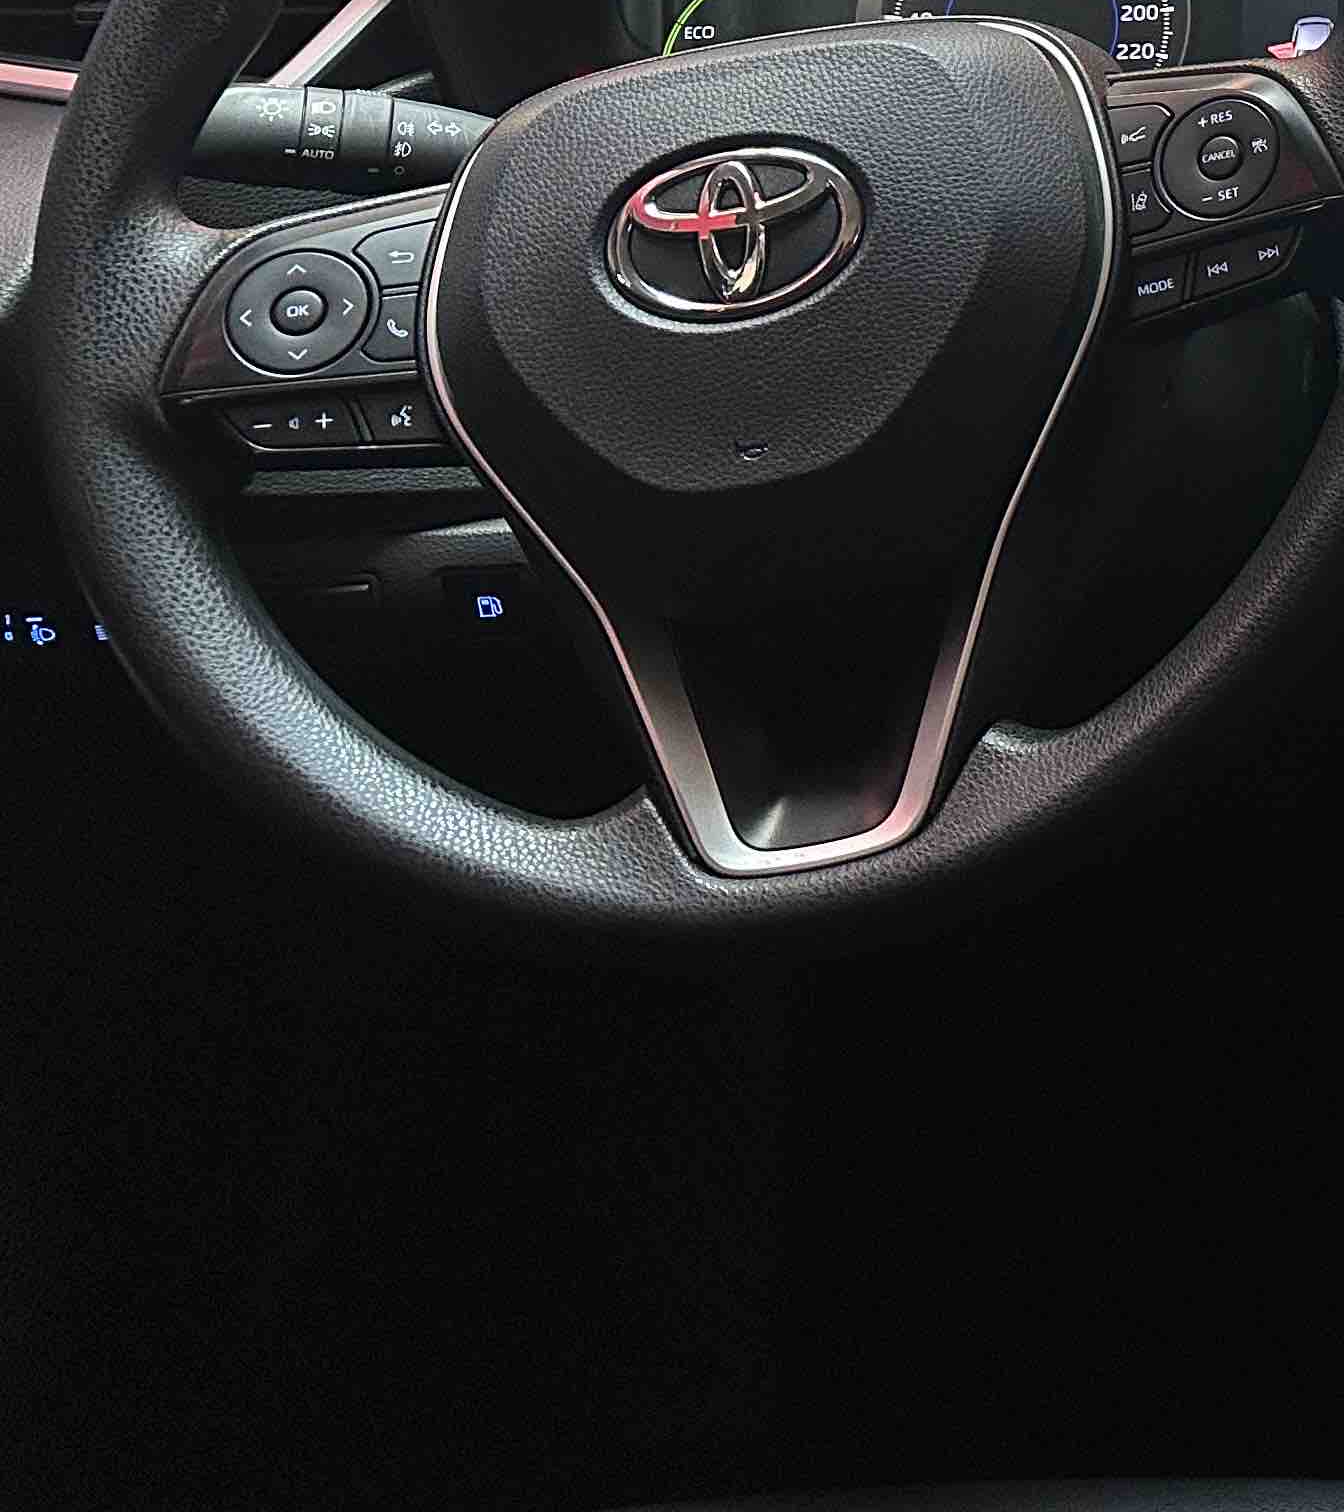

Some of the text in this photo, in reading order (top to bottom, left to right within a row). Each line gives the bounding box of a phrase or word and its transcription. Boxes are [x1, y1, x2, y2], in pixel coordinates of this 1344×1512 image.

[1120, 5, 1159, 22] 200
[684, 26, 715, 40] ECO
[1116, 43, 1155, 60] 220
[301, 149, 335, 160] AUTO
[1201, 149, 1236, 164] CANCEL
[1137, 277, 1175, 297] MODE
[286, 303, 310, 318] OK
